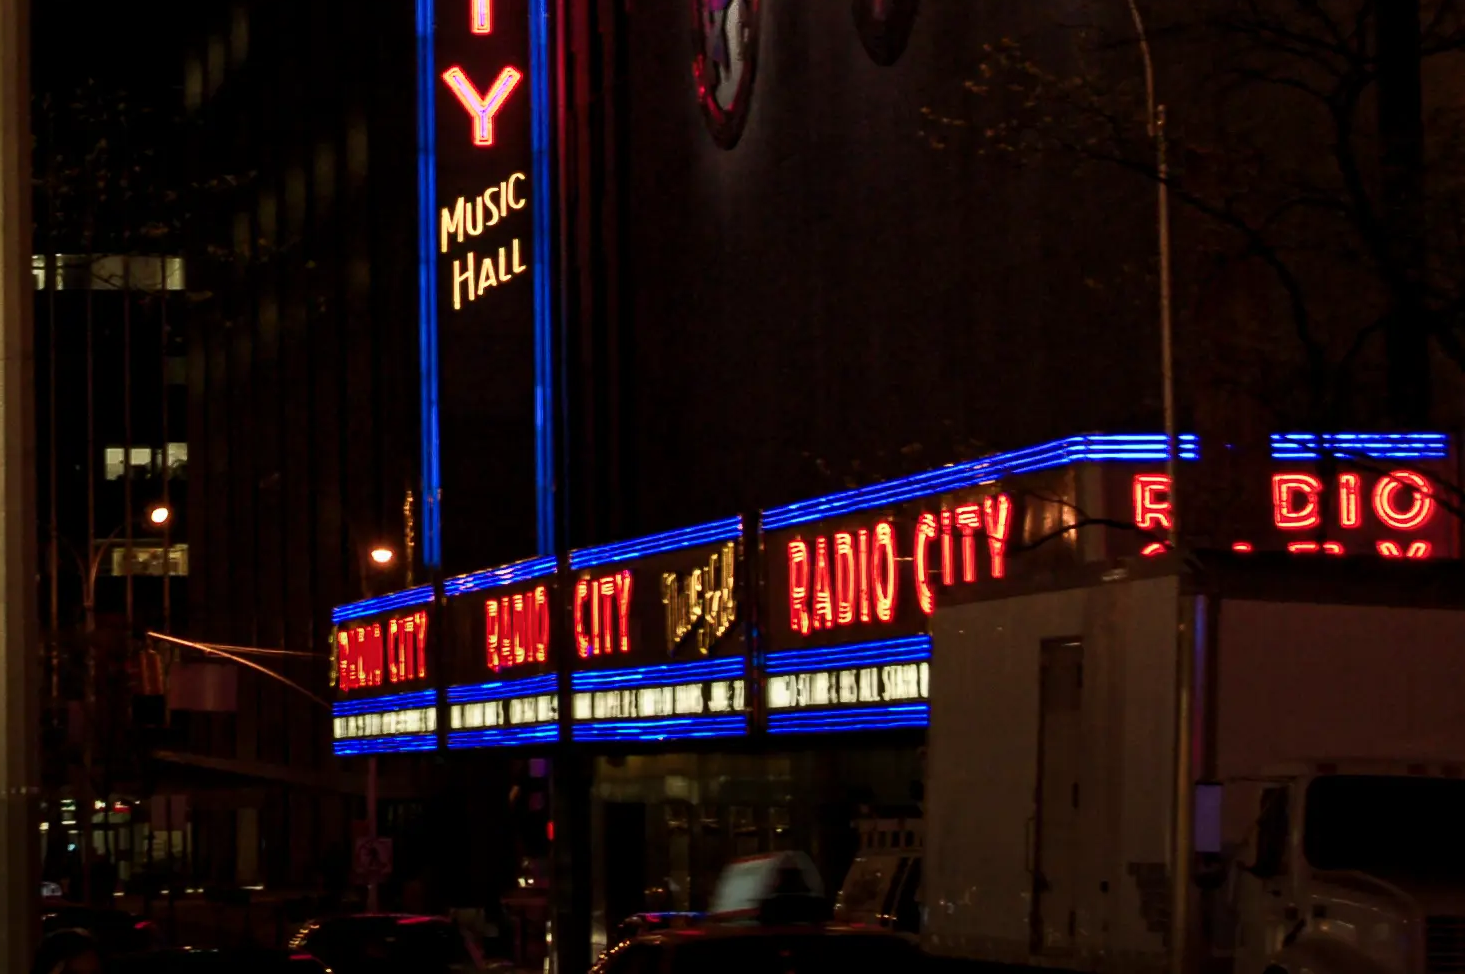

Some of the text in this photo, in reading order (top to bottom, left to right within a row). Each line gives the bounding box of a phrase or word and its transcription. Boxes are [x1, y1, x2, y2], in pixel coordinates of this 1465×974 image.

[441, 172, 526, 253] MUSIC
[453, 238, 527, 310] HALL
[1132, 470, 1434, 530] RDIO
[787, 521, 899, 637] RADIO
[912, 492, 1012, 616] CITY
[387, 610, 429, 683] CITY
[572, 570, 633, 659] CITY
